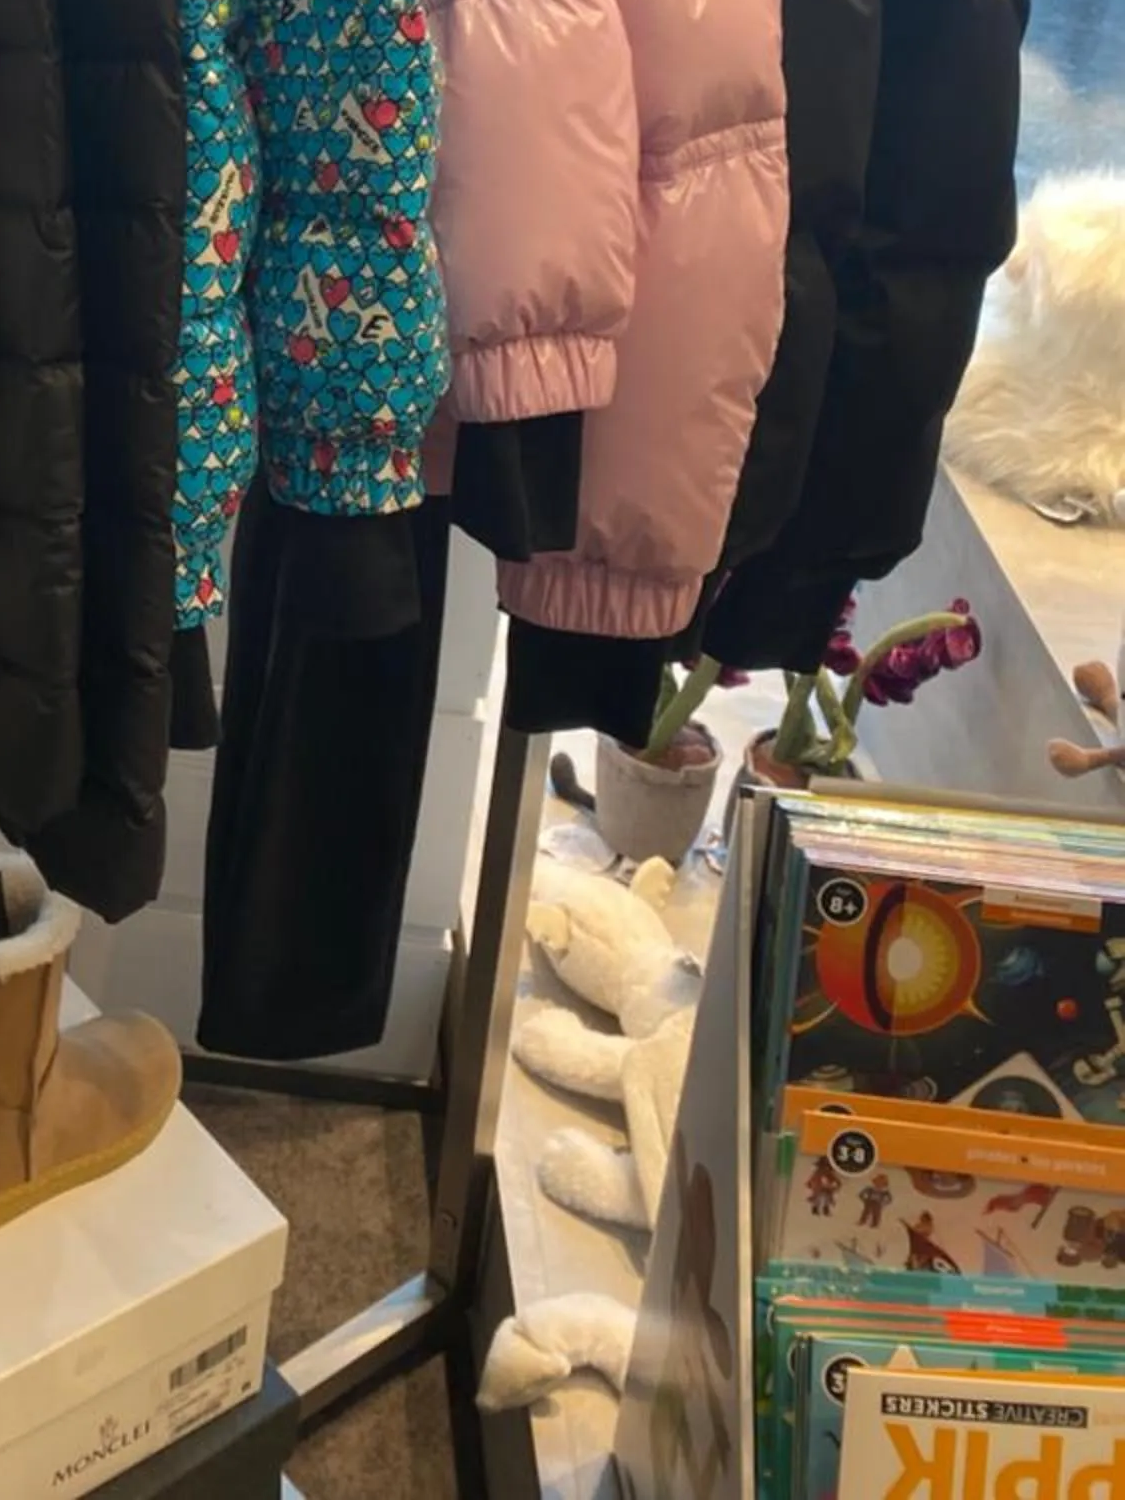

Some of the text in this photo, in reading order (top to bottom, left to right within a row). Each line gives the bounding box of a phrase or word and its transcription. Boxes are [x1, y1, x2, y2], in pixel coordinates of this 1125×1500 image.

[829, 896, 859, 916] 8+
[884, 1394, 1085, 1427] CREATIVE STICKERS
[883, 1421, 1125, 1500] PPIK
